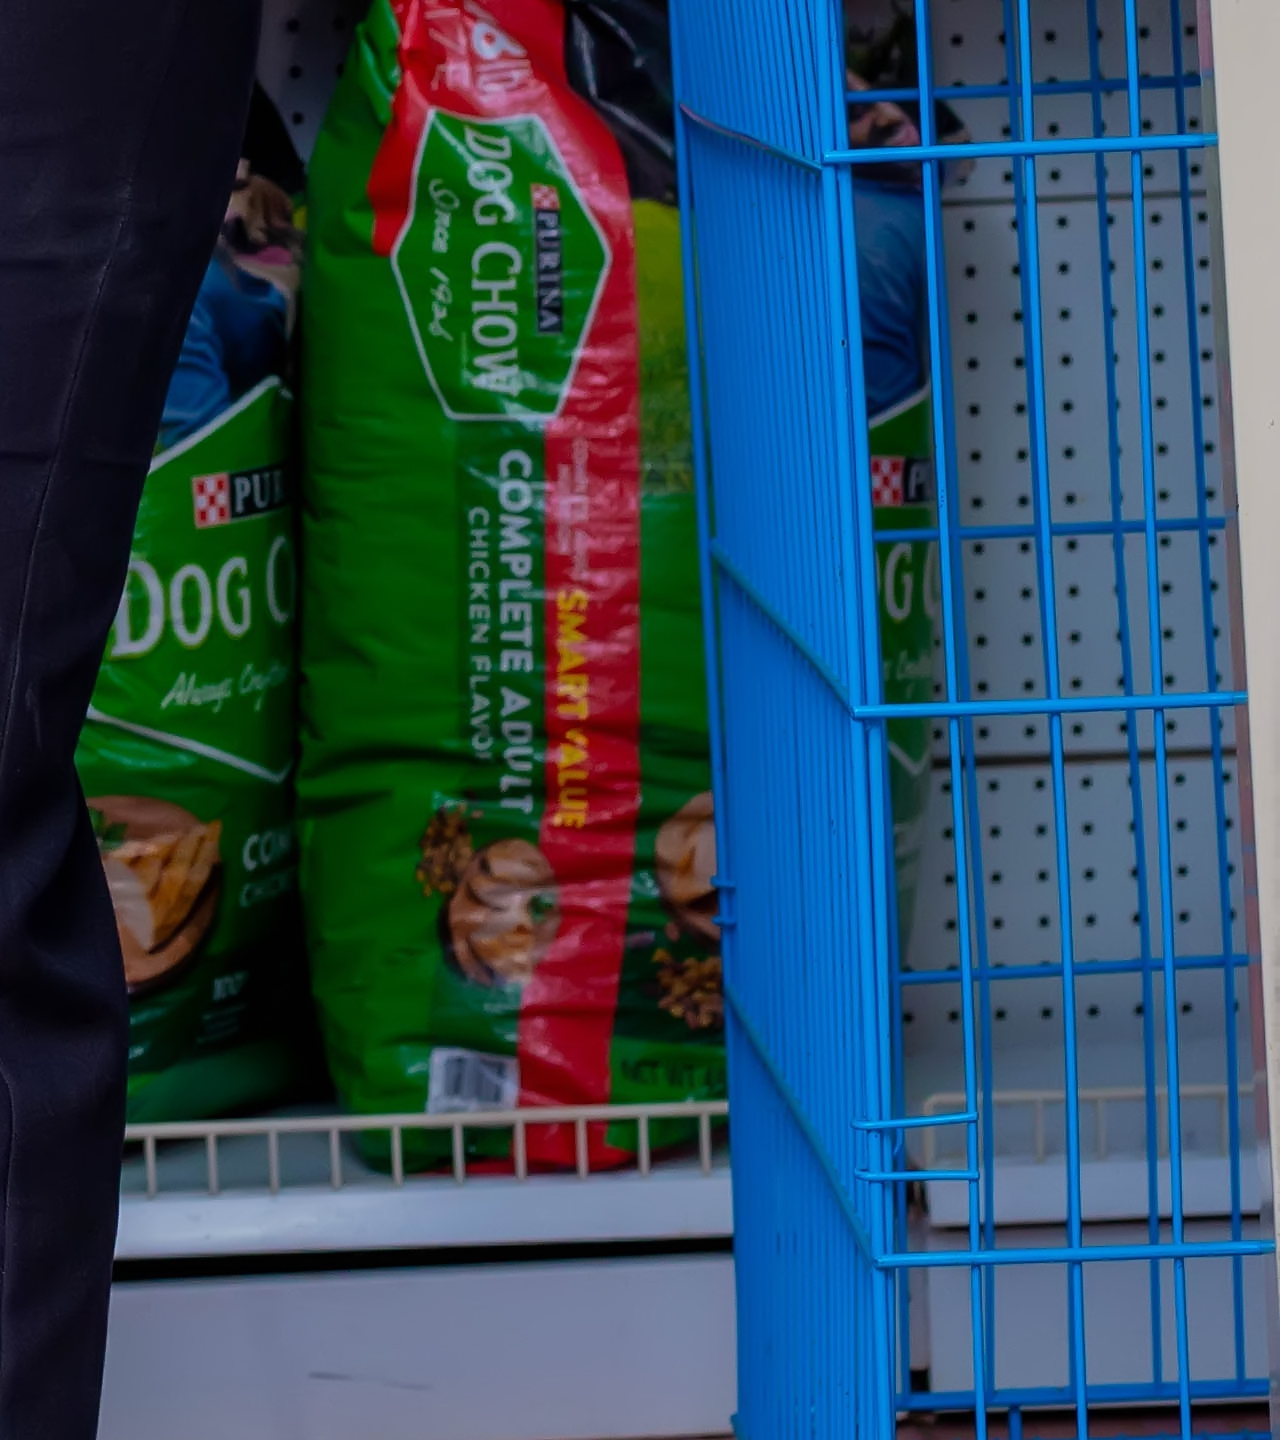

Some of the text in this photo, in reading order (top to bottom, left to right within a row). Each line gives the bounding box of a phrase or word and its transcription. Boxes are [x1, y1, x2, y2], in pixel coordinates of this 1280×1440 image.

[462, 126, 524, 400] DOG CHOW
[536, 210, 559, 333] PURINA
[109, 552, 253, 660] DOG
[468, 505, 489, 645] CHICKEN
[497, 447, 534, 815] COMPLETE ADULT
[555, 588, 589, 720] SMART
